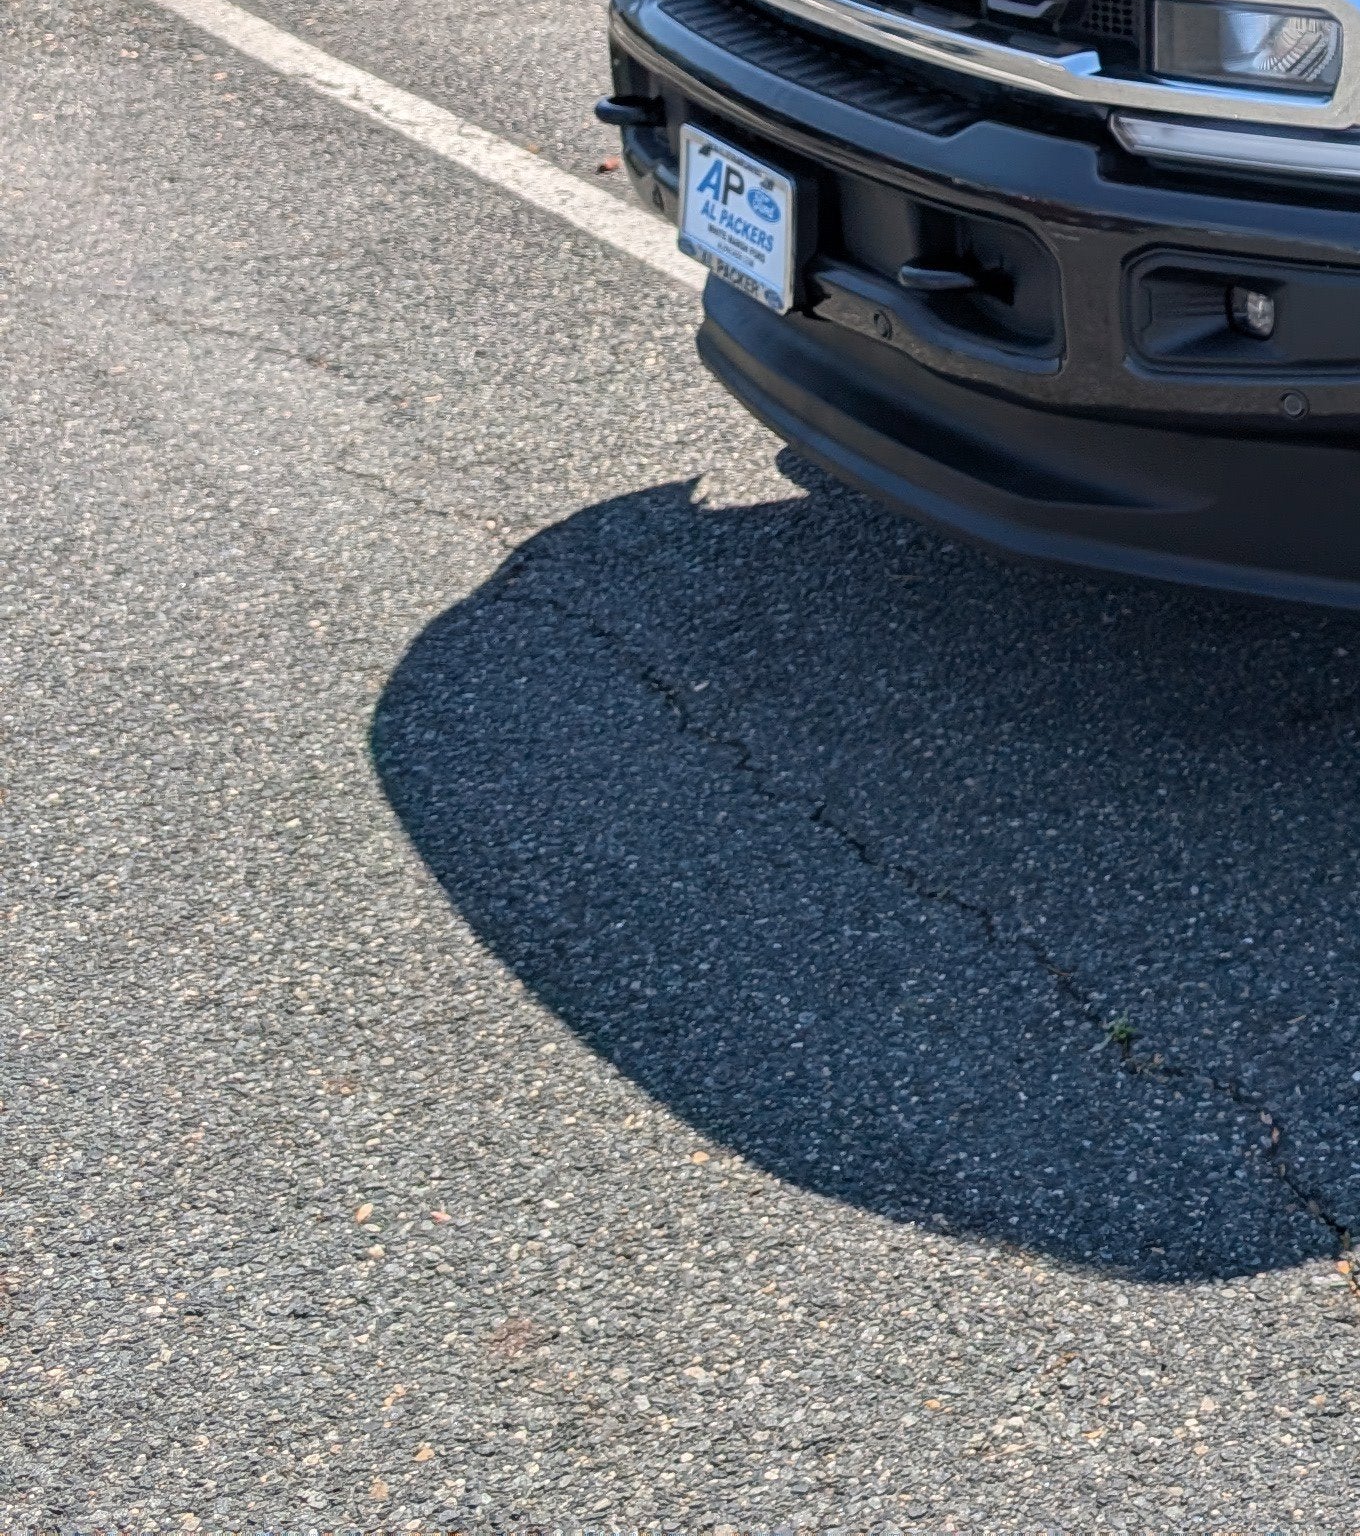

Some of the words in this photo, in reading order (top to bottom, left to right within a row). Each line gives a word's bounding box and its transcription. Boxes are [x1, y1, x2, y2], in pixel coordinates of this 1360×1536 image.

[696, 158, 745, 206] AP
[701, 199, 716, 221] AL
[719, 208, 775, 254] PACKERS
